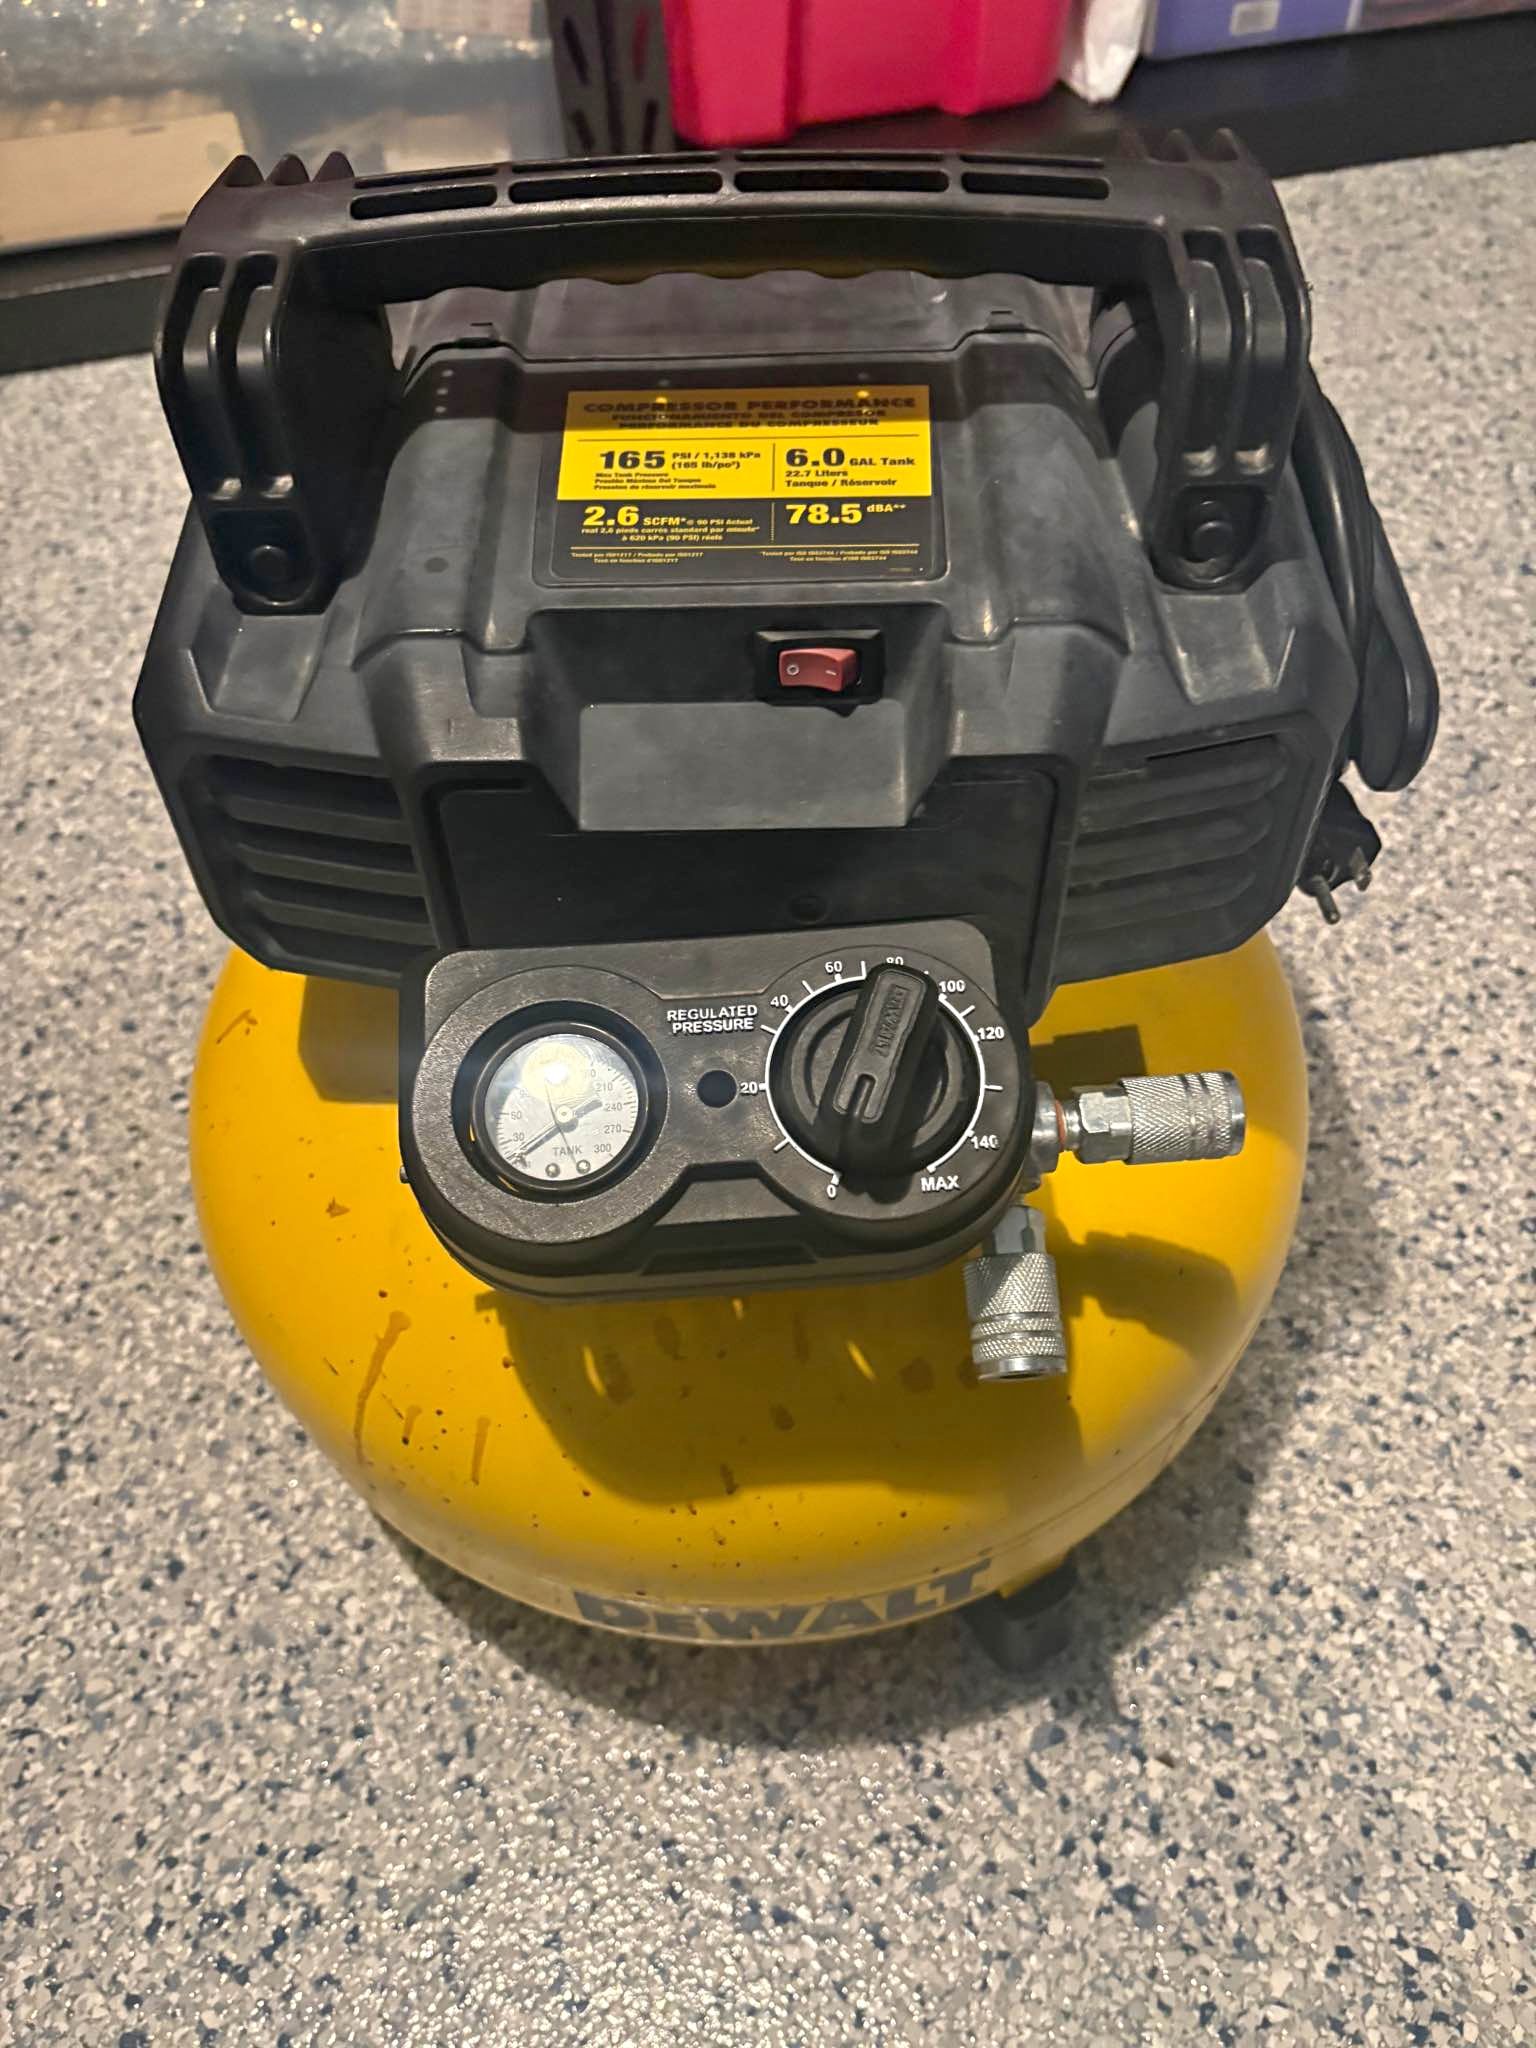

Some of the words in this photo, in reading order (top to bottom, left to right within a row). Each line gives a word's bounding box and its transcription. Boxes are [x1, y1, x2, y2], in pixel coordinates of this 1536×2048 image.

[584, 401, 737, 412] COMPRESSOR
[747, 397, 915, 410] PERFORMANCE
[600, 450, 665, 470] 165
[703, 452, 736, 460] 1,138
[739, 451, 761, 459] kPa
[786, 448, 845, 467] 6.0
[849, 458, 876, 466] GAL
[880, 457, 915, 466] Tank
[672, 462, 698, 470] (165
[785, 479, 829, 488] Tanque
[583, 505, 640, 526] 2.6
[785, 503, 863, 525] 78.5
[825, 961, 843, 974] 60
[939, 979, 966, 992] 100
[770, 994, 789, 1008] 40
[666, 1004, 758, 1022] REGULATED
[672, 1018, 754, 1034] PRESSURE
[977, 1026, 1005, 1040] 120
[740, 1081, 758, 1095] 20
[512, 1132, 525, 1142] 30
[971, 1135, 998, 1149] 140
[552, 1145, 583, 1157] TANK
[594, 1144, 612, 1153] 300
[921, 1176, 960, 1192] MAX
[827, 1185, 836, 1198] 0
[573, 1556, 992, 1639] DEWALT
